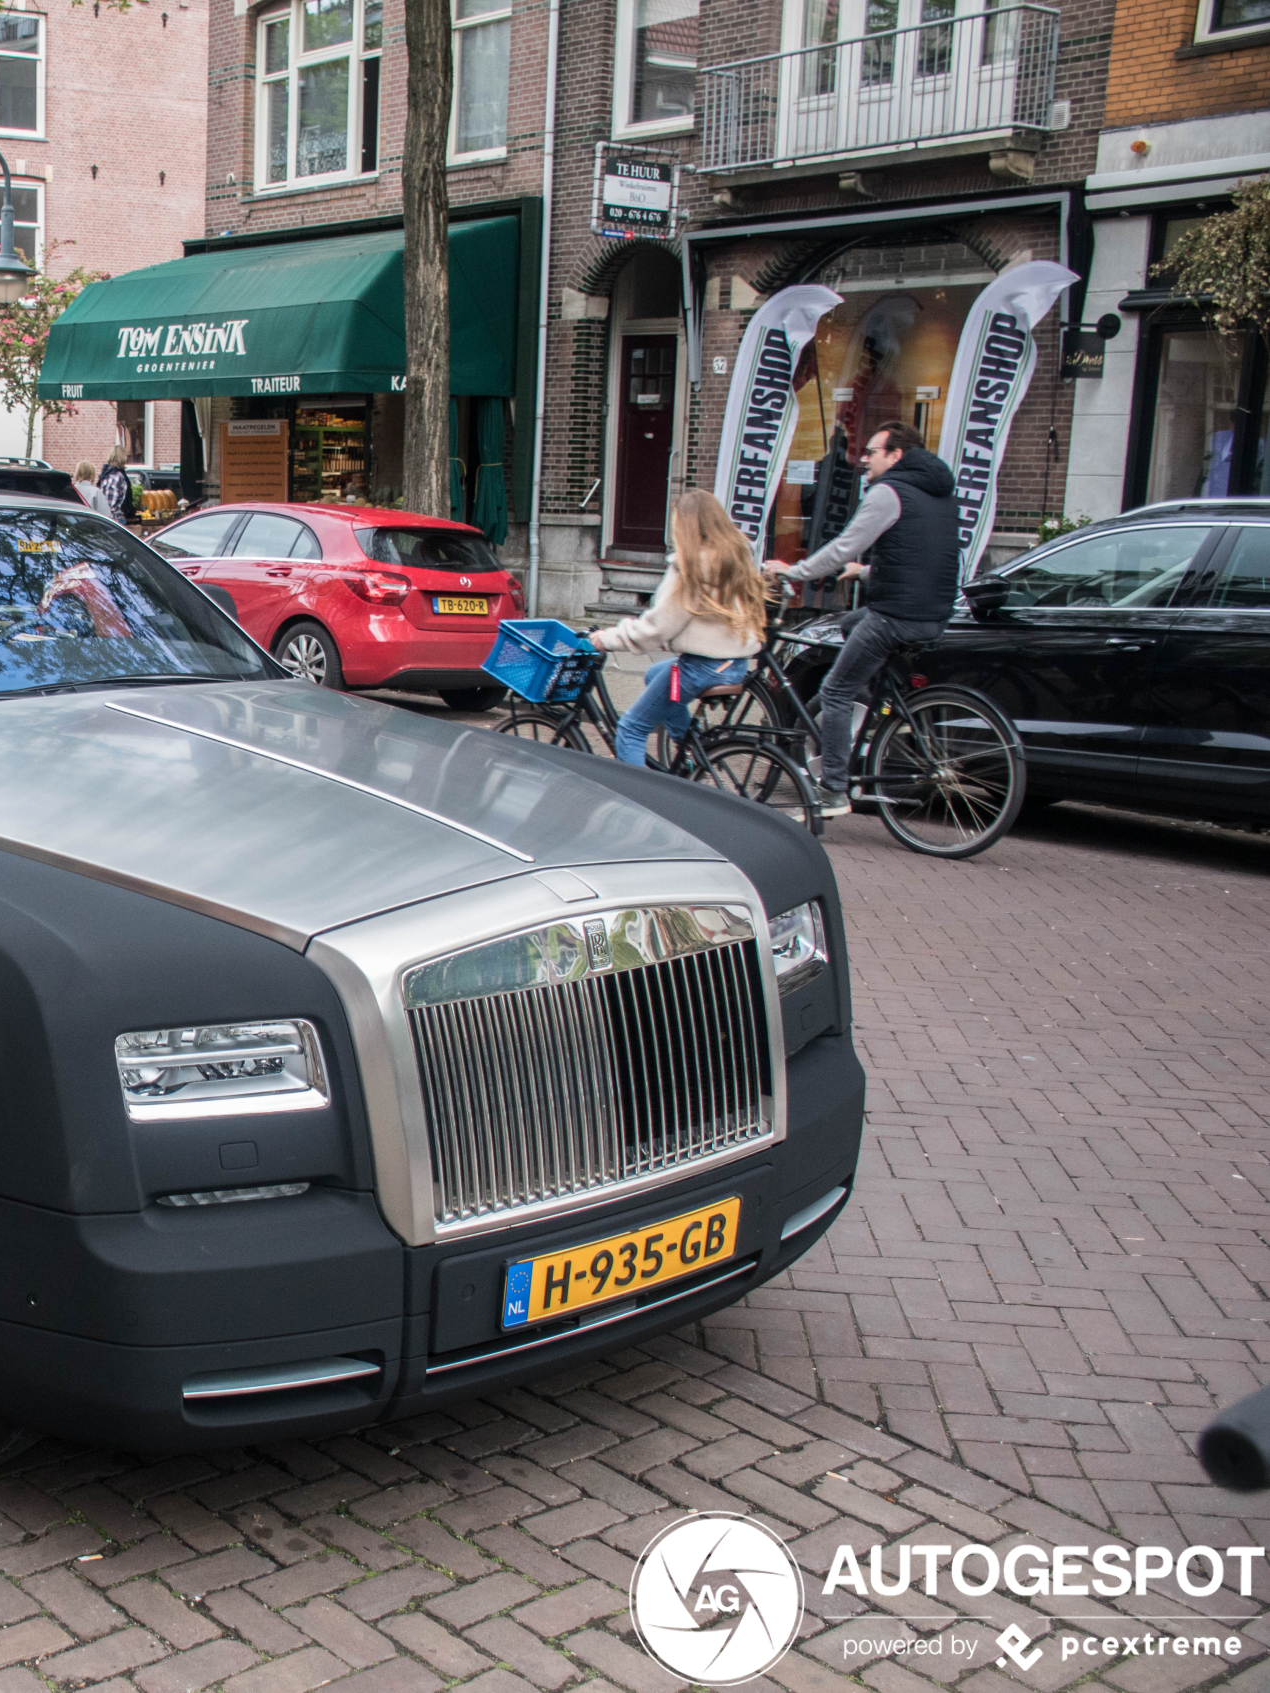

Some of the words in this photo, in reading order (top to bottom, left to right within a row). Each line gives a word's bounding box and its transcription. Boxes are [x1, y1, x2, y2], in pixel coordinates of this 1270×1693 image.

[616, 163, 629, 176] TE
[630, 165, 660, 180] HUUR
[609, 207, 623, 218] 020
[628, 209, 641, 220] 676
[648, 211, 661, 222] 676
[136, 360, 215, 373] GROENTENIER
[62, 384, 83, 398] FRUIT
[251, 376, 301, 393] TRAITEUR
[390, 376, 407, 391] KA
[441, 599, 485, 612] TB-620-R
[543, 1213, 727, 1309] H-935-GB
[507, 1300, 525, 1316] NL
